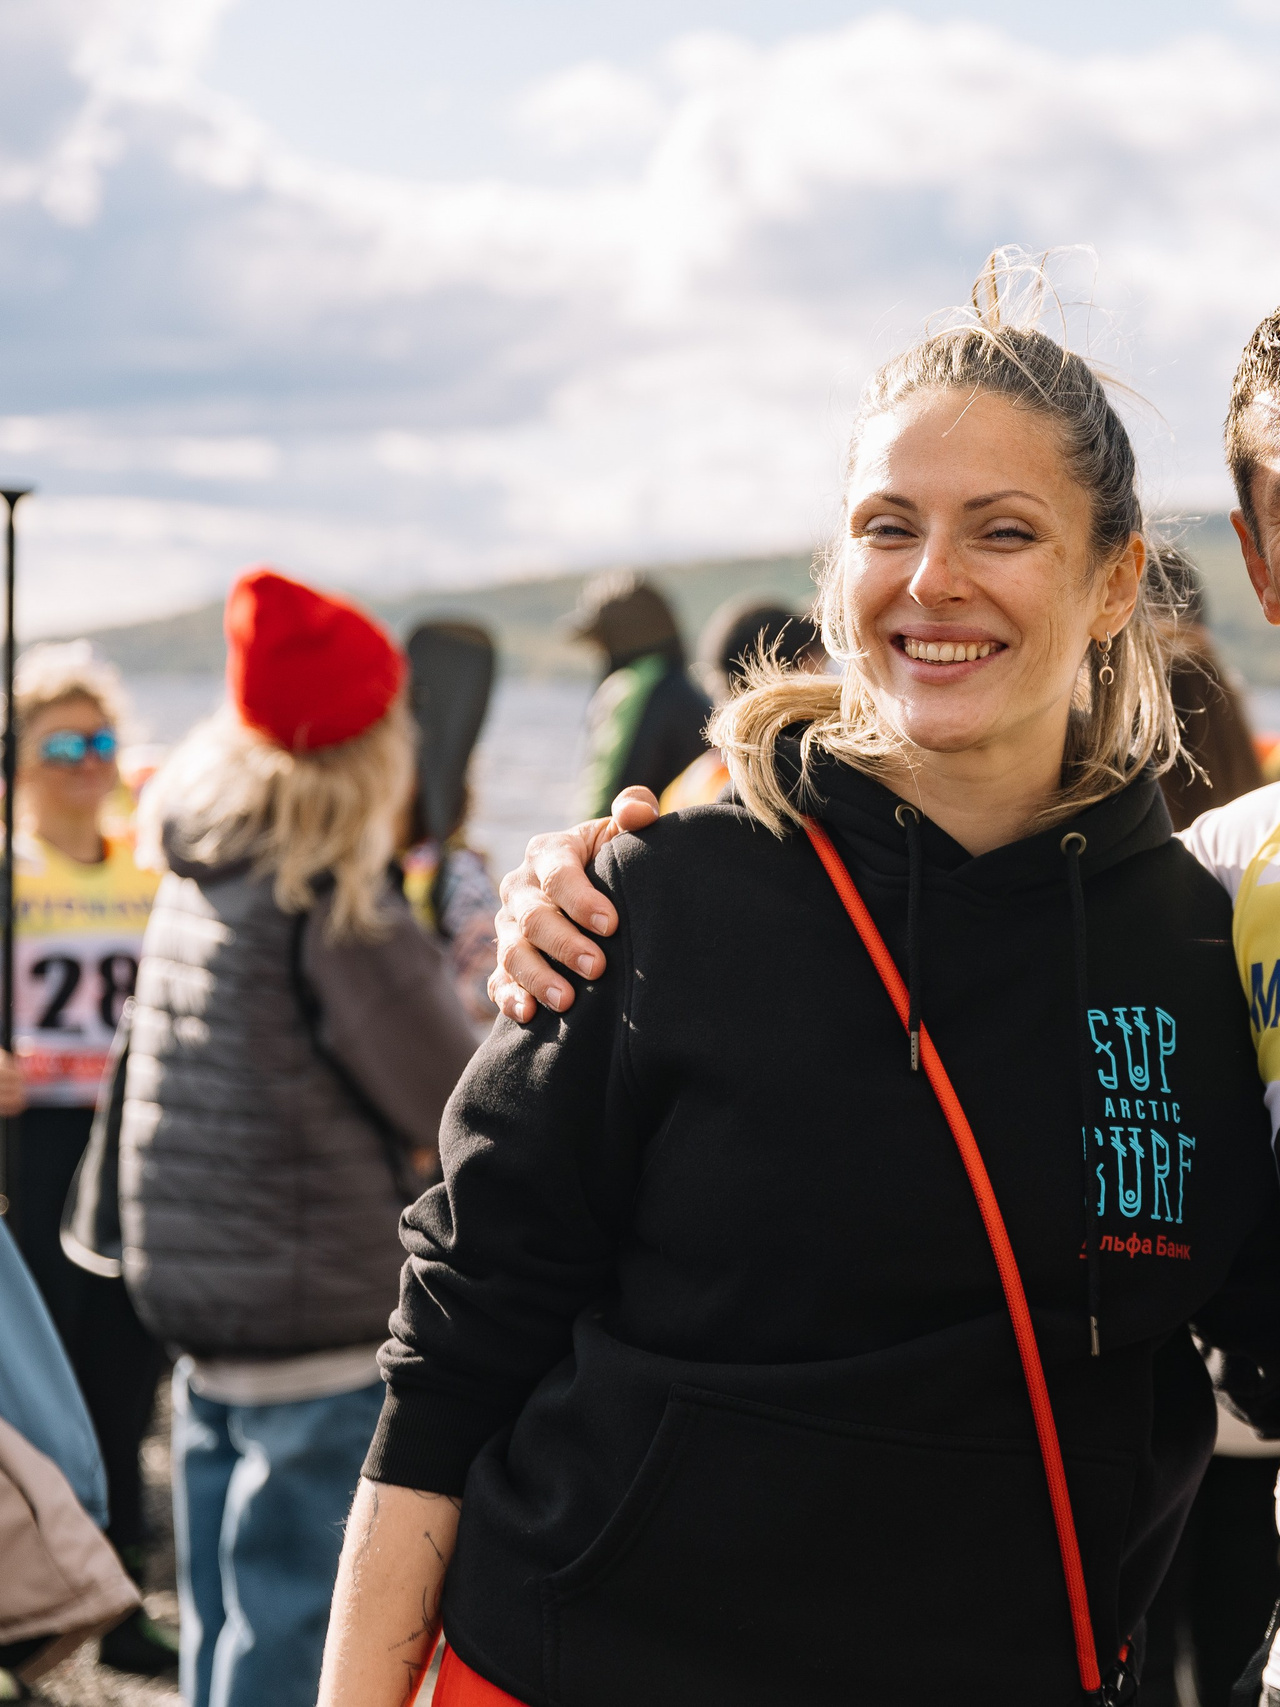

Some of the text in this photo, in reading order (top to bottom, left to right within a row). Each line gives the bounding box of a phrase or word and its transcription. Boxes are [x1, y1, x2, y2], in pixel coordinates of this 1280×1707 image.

[1087, 1006, 1176, 1093] SUP
[1104, 1097, 1180, 1124] ARCTIC
[1156, 1234, 1192, 1261] Банк
